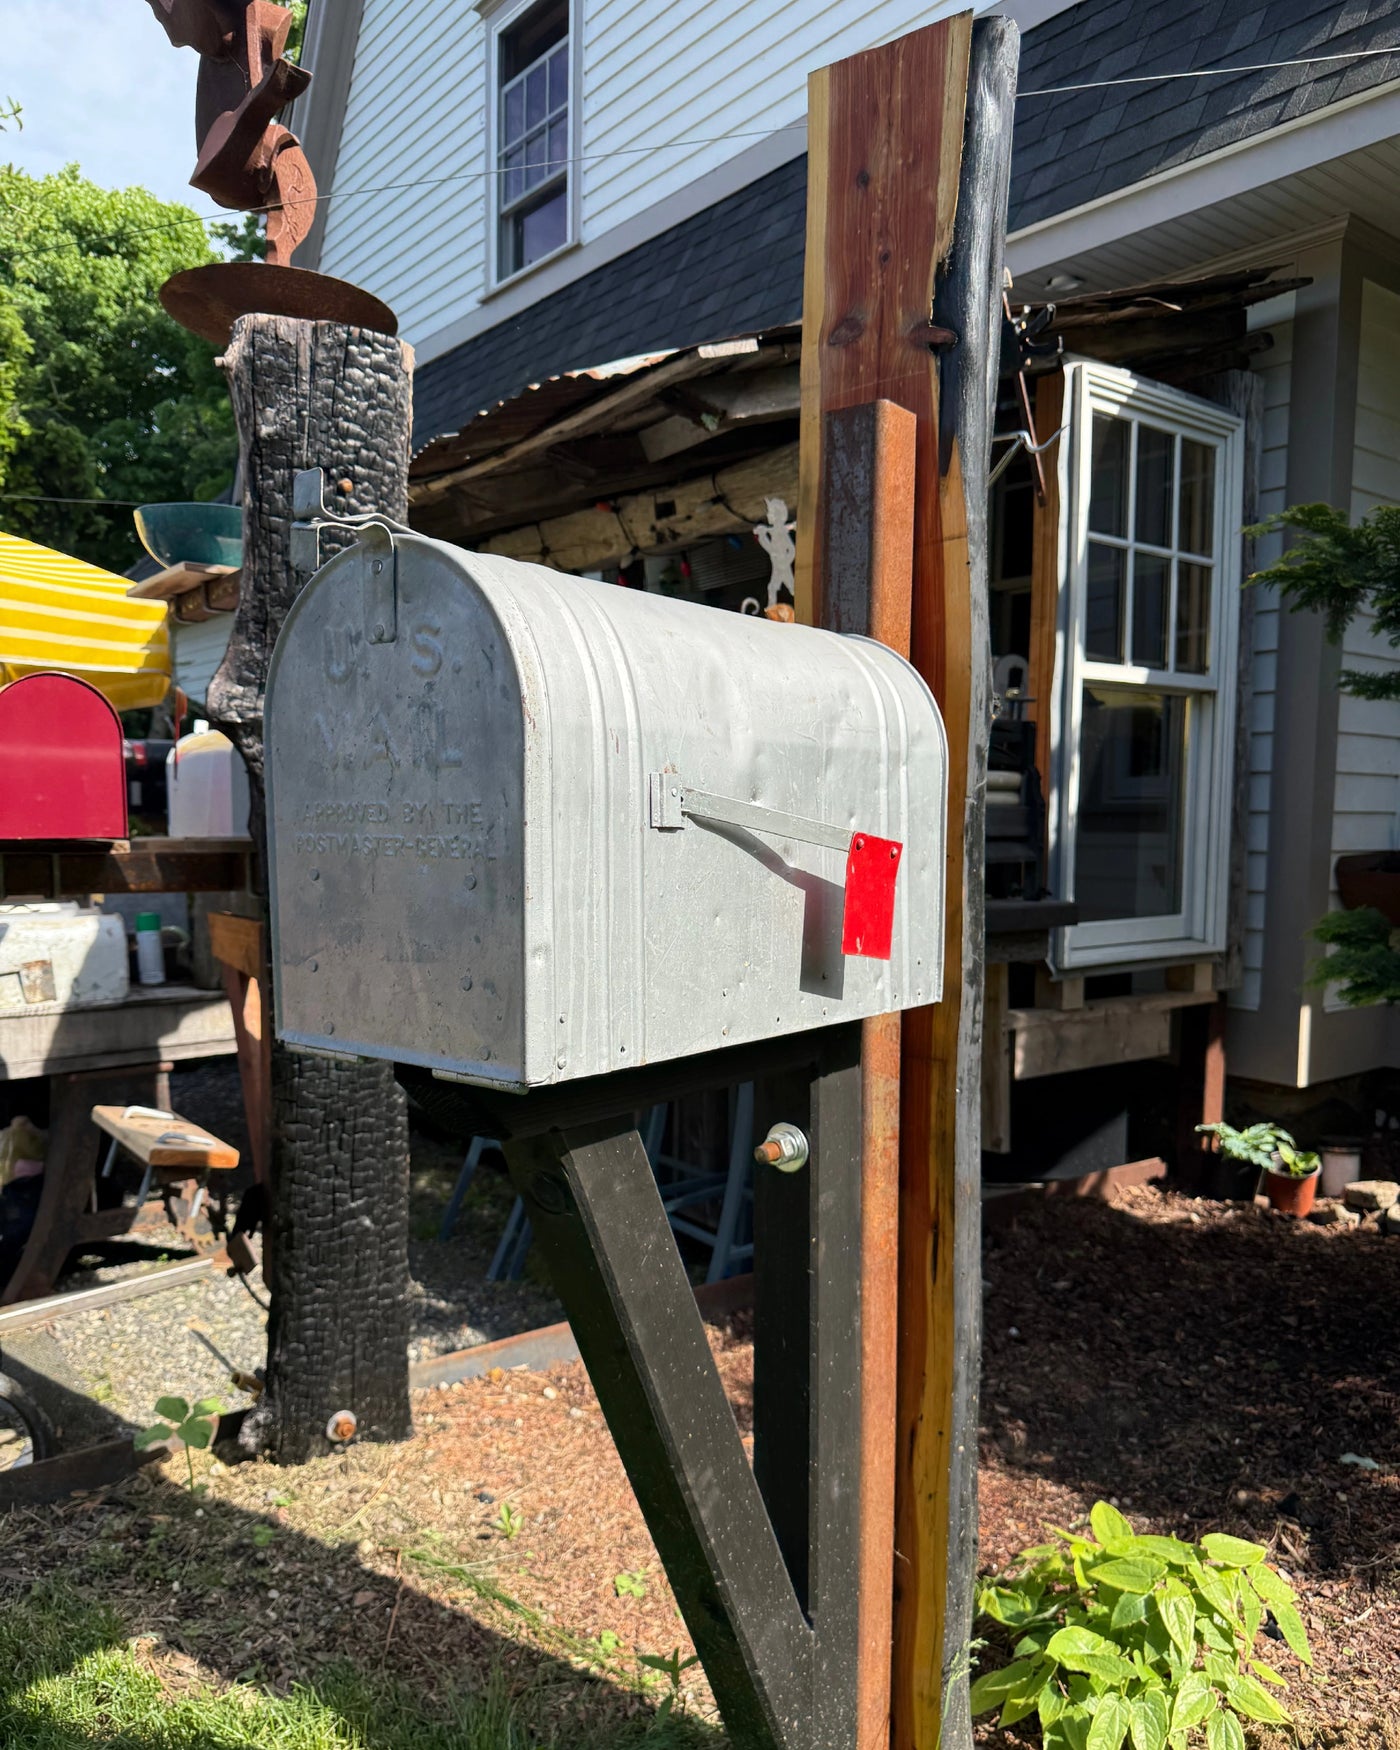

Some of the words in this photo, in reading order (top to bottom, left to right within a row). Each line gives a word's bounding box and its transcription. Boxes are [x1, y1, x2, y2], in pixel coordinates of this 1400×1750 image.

[301, 801, 391, 826] APPROVED
[402, 802, 429, 826] BY
[444, 802, 484, 826] THE
